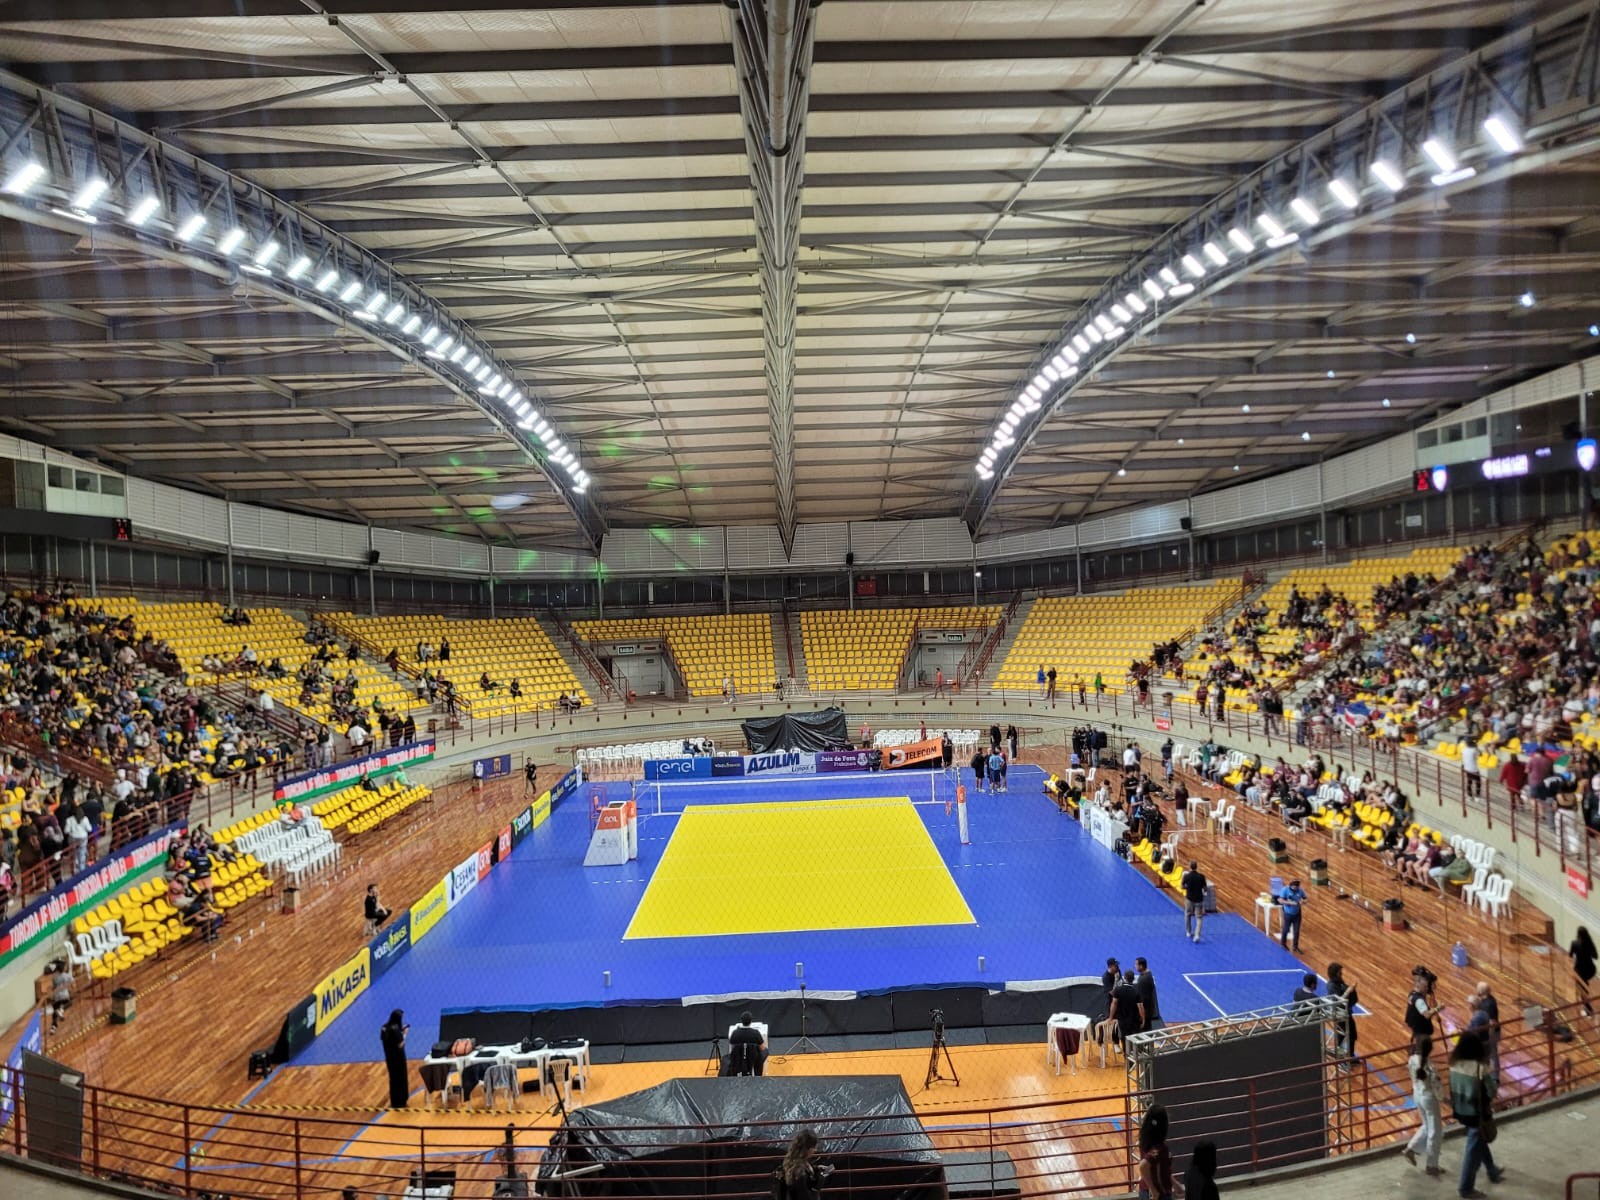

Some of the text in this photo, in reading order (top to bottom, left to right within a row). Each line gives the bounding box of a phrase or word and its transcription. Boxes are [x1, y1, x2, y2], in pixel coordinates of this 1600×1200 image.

[905, 746, 937, 760] TELECOM
[660, 758, 695, 774] enel
[747, 752, 800, 774] AZULIM
[9, 911, 41, 951] TORCIDA
